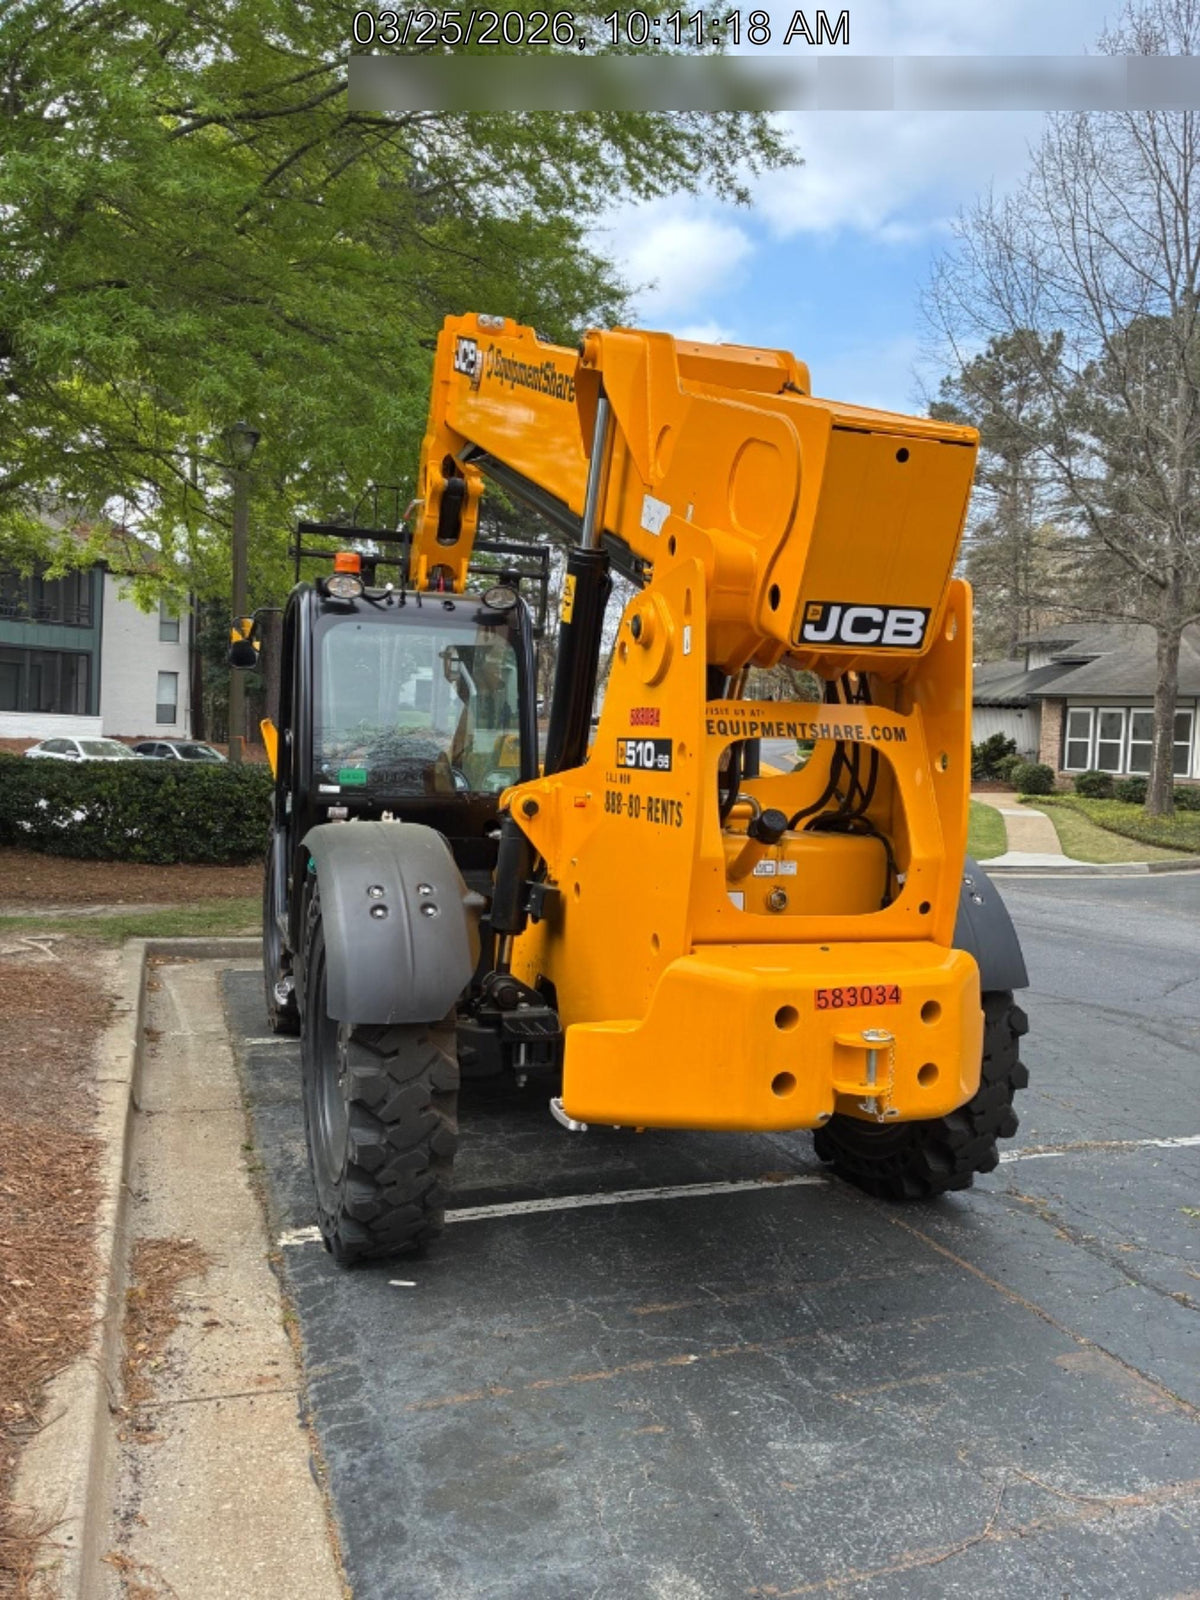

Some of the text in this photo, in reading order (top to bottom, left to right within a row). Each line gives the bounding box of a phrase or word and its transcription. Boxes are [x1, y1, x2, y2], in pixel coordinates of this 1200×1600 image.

[494, 347, 575, 402] EquipmentShare
[803, 605, 925, 645] JCB
[706, 718, 908, 743] EQUIPMENTSHARE.COM
[604, 789, 684, 828] 888-80-RENTS
[817, 984, 901, 1010] 583034
